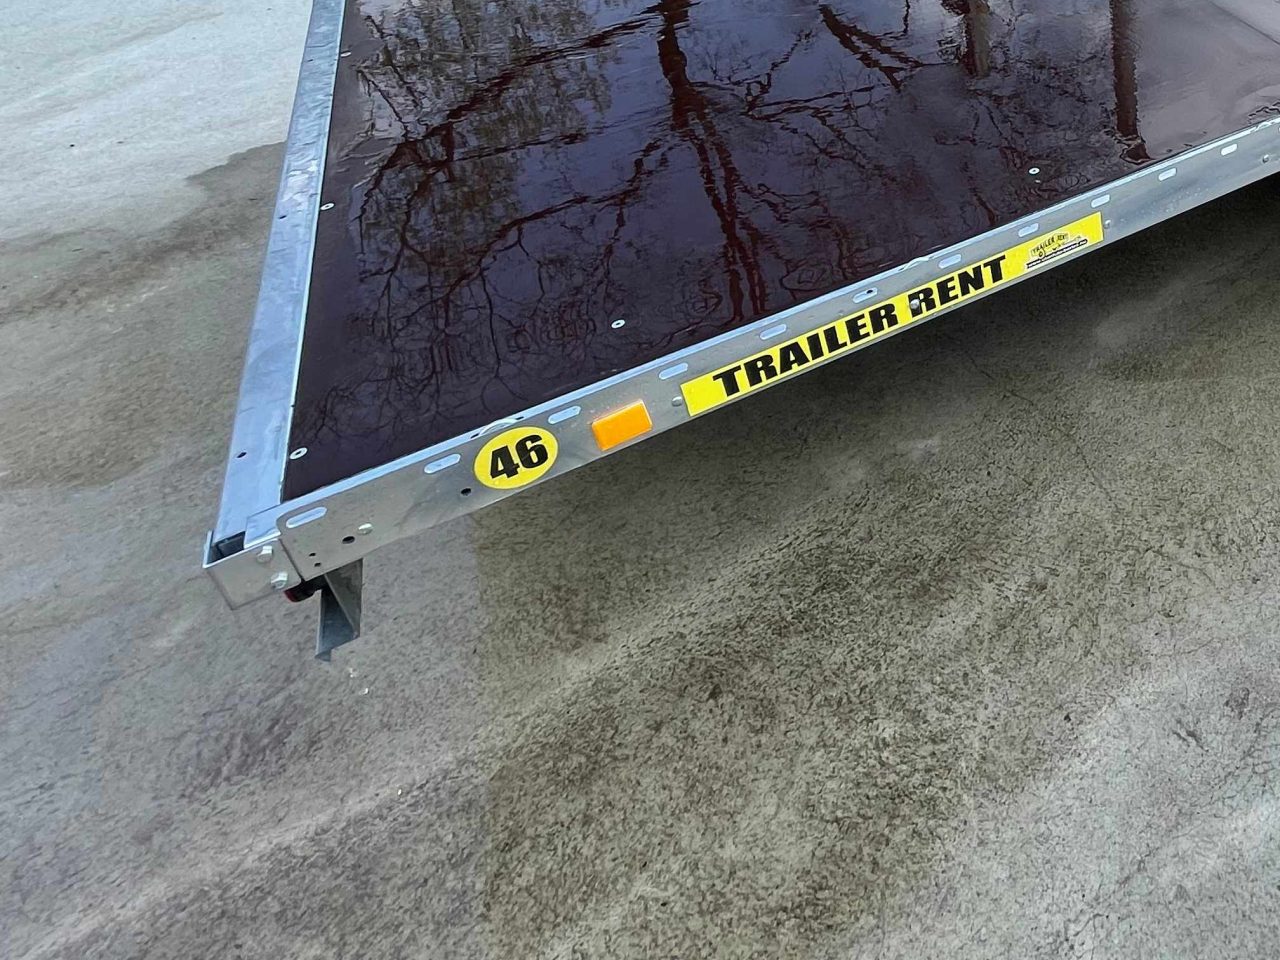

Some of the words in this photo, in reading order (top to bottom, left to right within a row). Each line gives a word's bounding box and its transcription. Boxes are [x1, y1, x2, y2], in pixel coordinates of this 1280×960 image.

[712, 302, 899, 397] TRAILER
[906, 254, 1006, 317] RENT
[490, 434, 548, 479] 46
